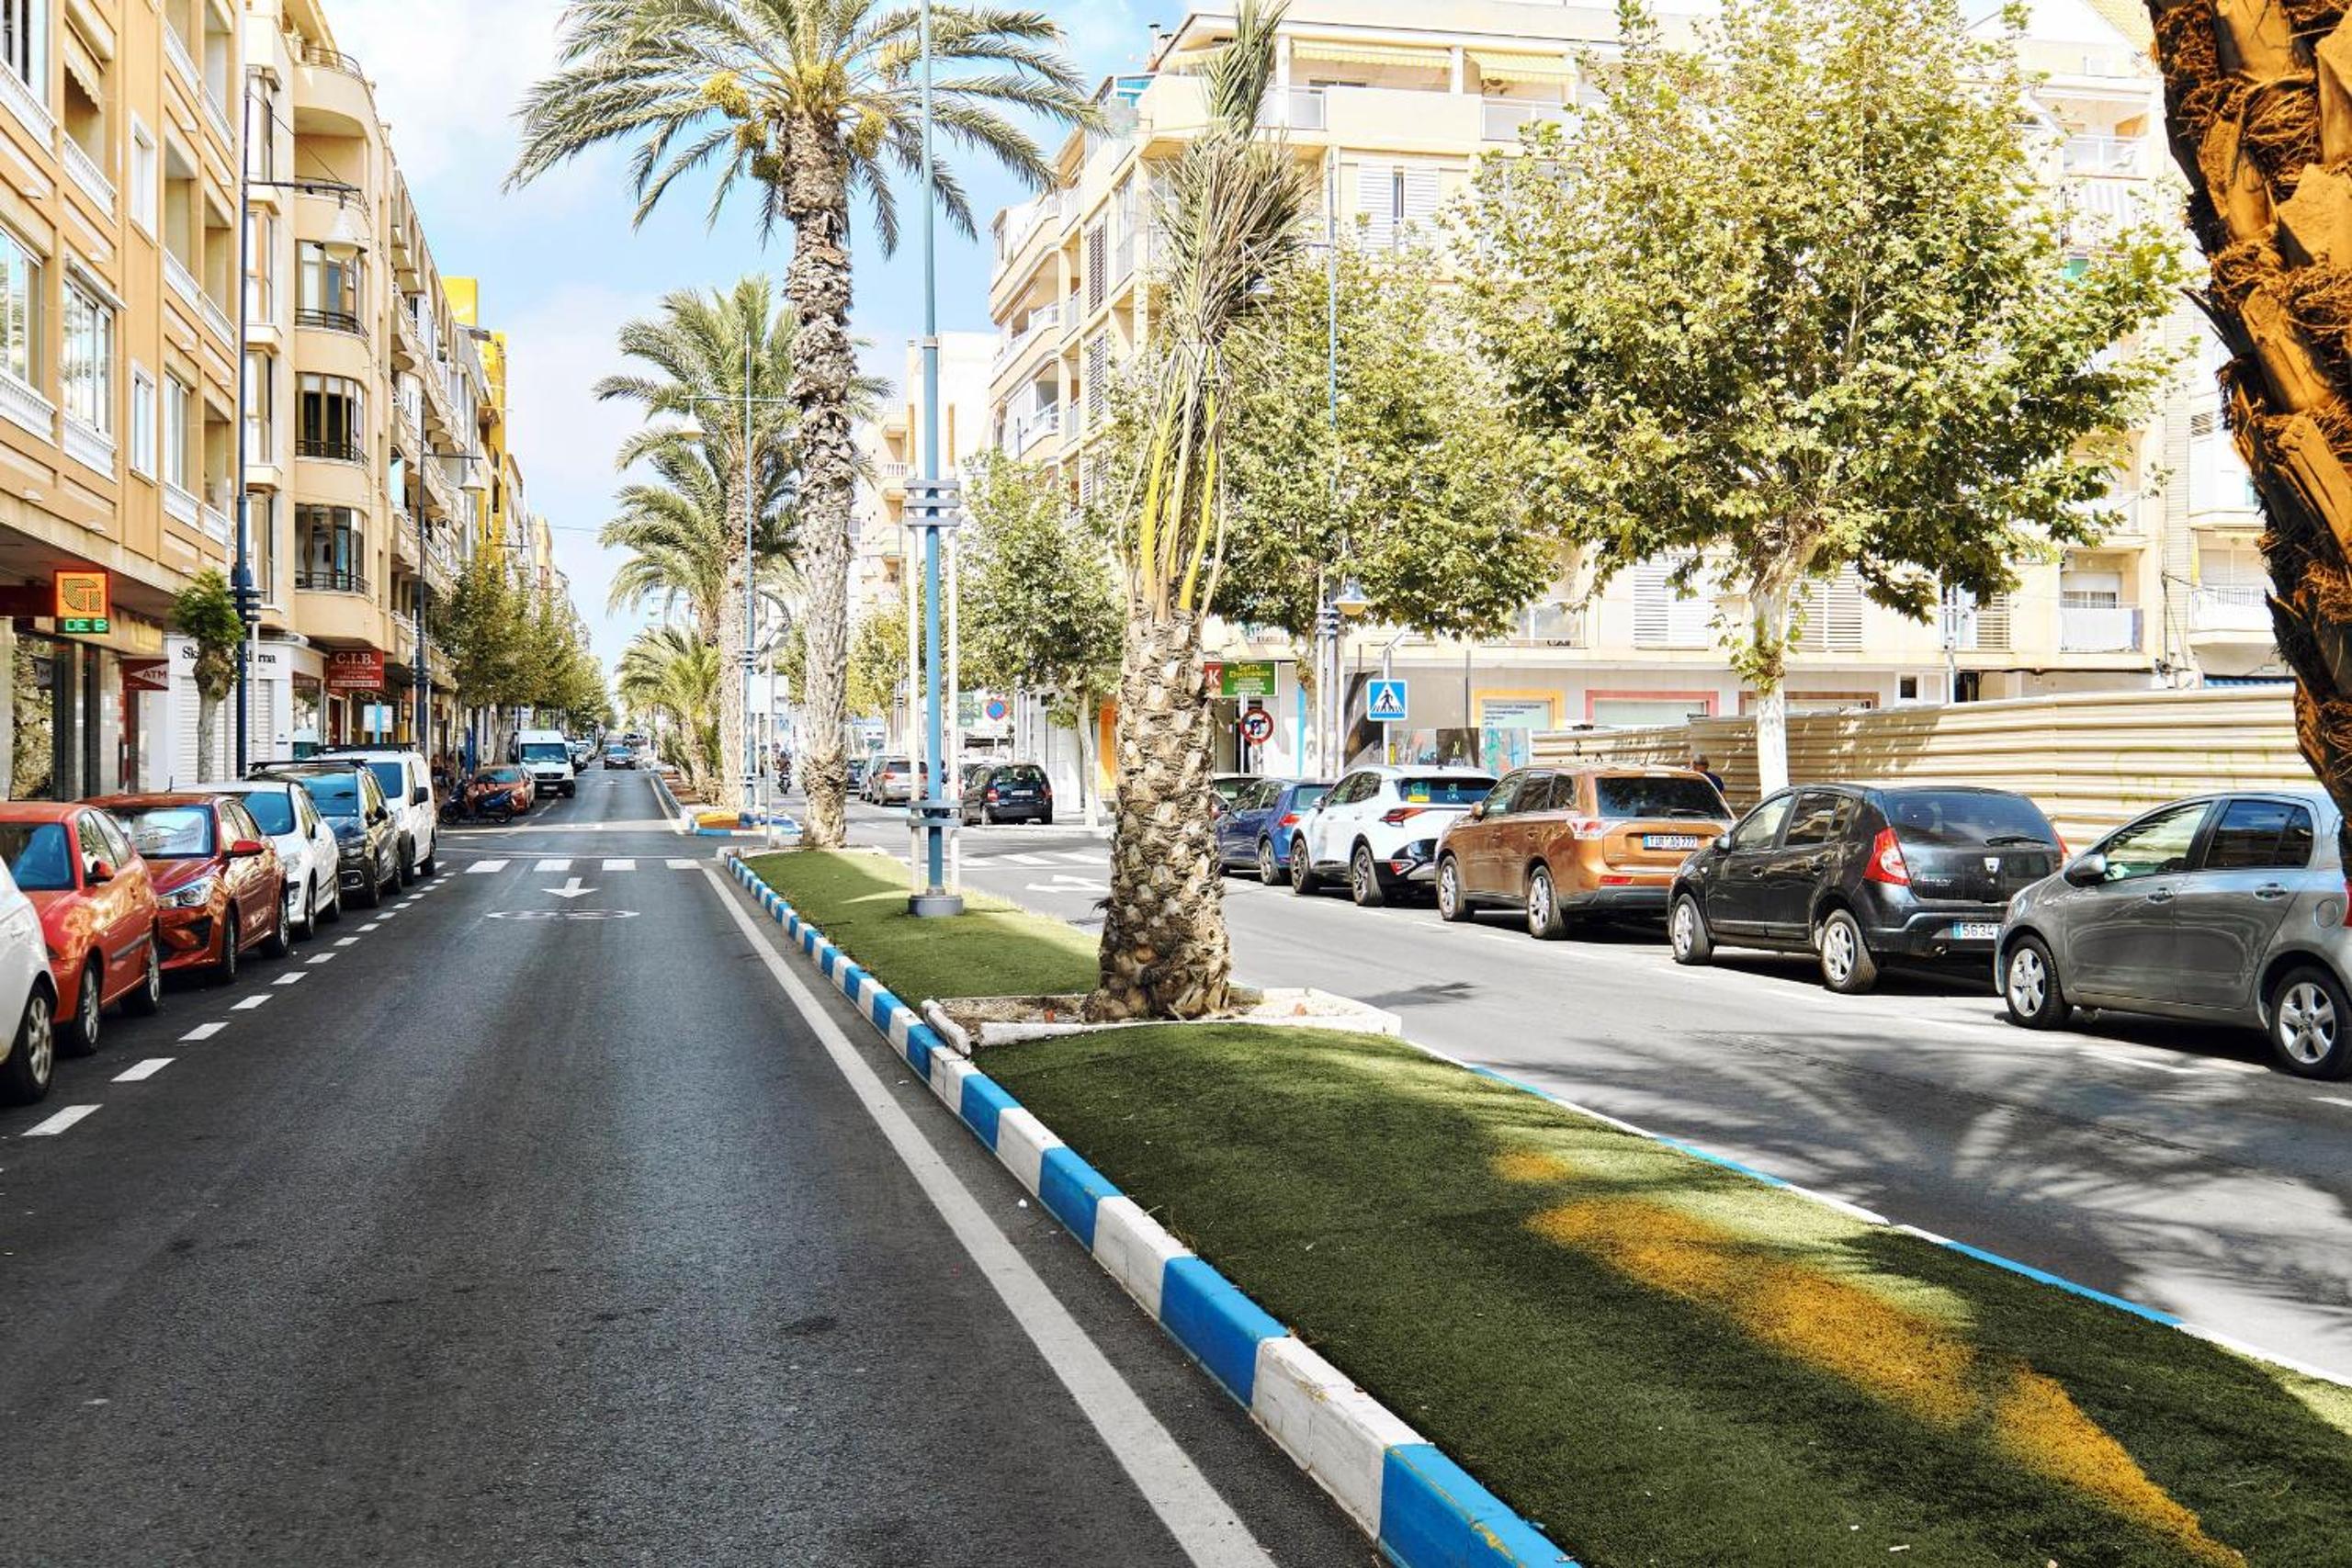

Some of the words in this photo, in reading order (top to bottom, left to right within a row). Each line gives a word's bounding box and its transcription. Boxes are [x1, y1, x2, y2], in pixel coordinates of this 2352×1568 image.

[65, 618, 91, 632] DE
[335, 652, 376, 665] C.I.B.
[142, 670, 167, 680] ATM
